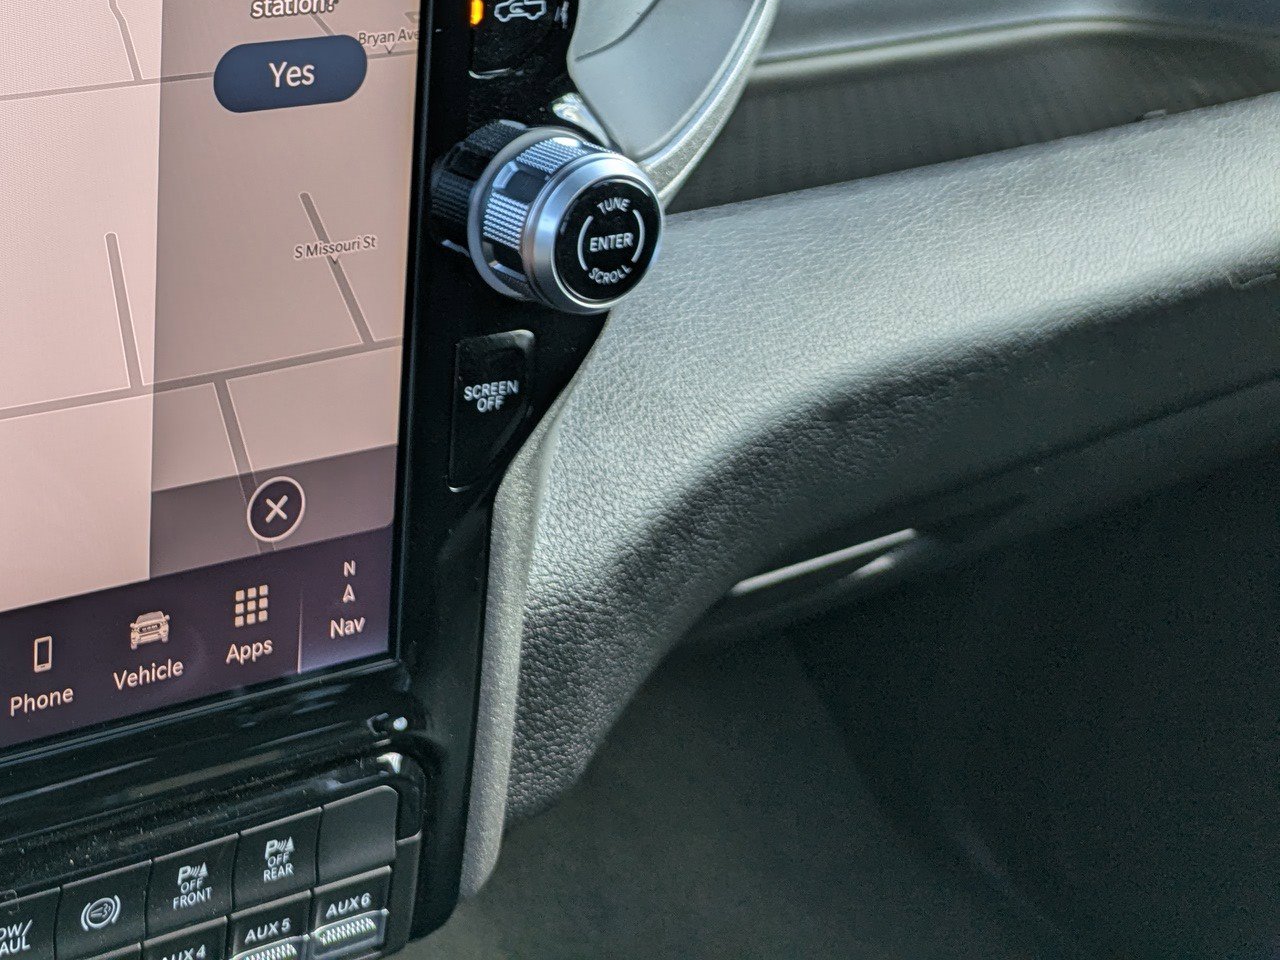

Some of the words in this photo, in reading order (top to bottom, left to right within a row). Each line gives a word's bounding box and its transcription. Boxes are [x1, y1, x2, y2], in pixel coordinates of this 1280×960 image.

[359, 32, 395, 47] Bryan
[398, 28, 420, 41] Ave
[269, 61, 316, 88] Yes
[597, 197, 631, 214] TUNE
[294, 246, 303, 259] S
[306, 237, 360, 257] Missouri
[363, 235, 376, 249] St
[589, 232, 634, 252] ENTER
[588, 265, 632, 285] SCROLL
[463, 379, 519, 401] SCREEN
[476, 395, 505, 413] OFF
[330, 616, 366, 640] Nav
[226, 638, 273, 666] Apps
[113, 658, 184, 691] Vehicle
[10, 687, 74, 717] Phone
[267, 852, 290, 868] OFF
[263, 863, 294, 882] REAR
[180, 877, 204, 895] OFF
[173, 886, 213, 910] FRONT
[326, 899, 359, 919] AUX
[360, 893, 371, 907] 6
[244, 922, 279, 945] AUX
[281, 917, 291, 933] 5
[162, 948, 195, 960] UX
[195, 944, 207, 960] 4
